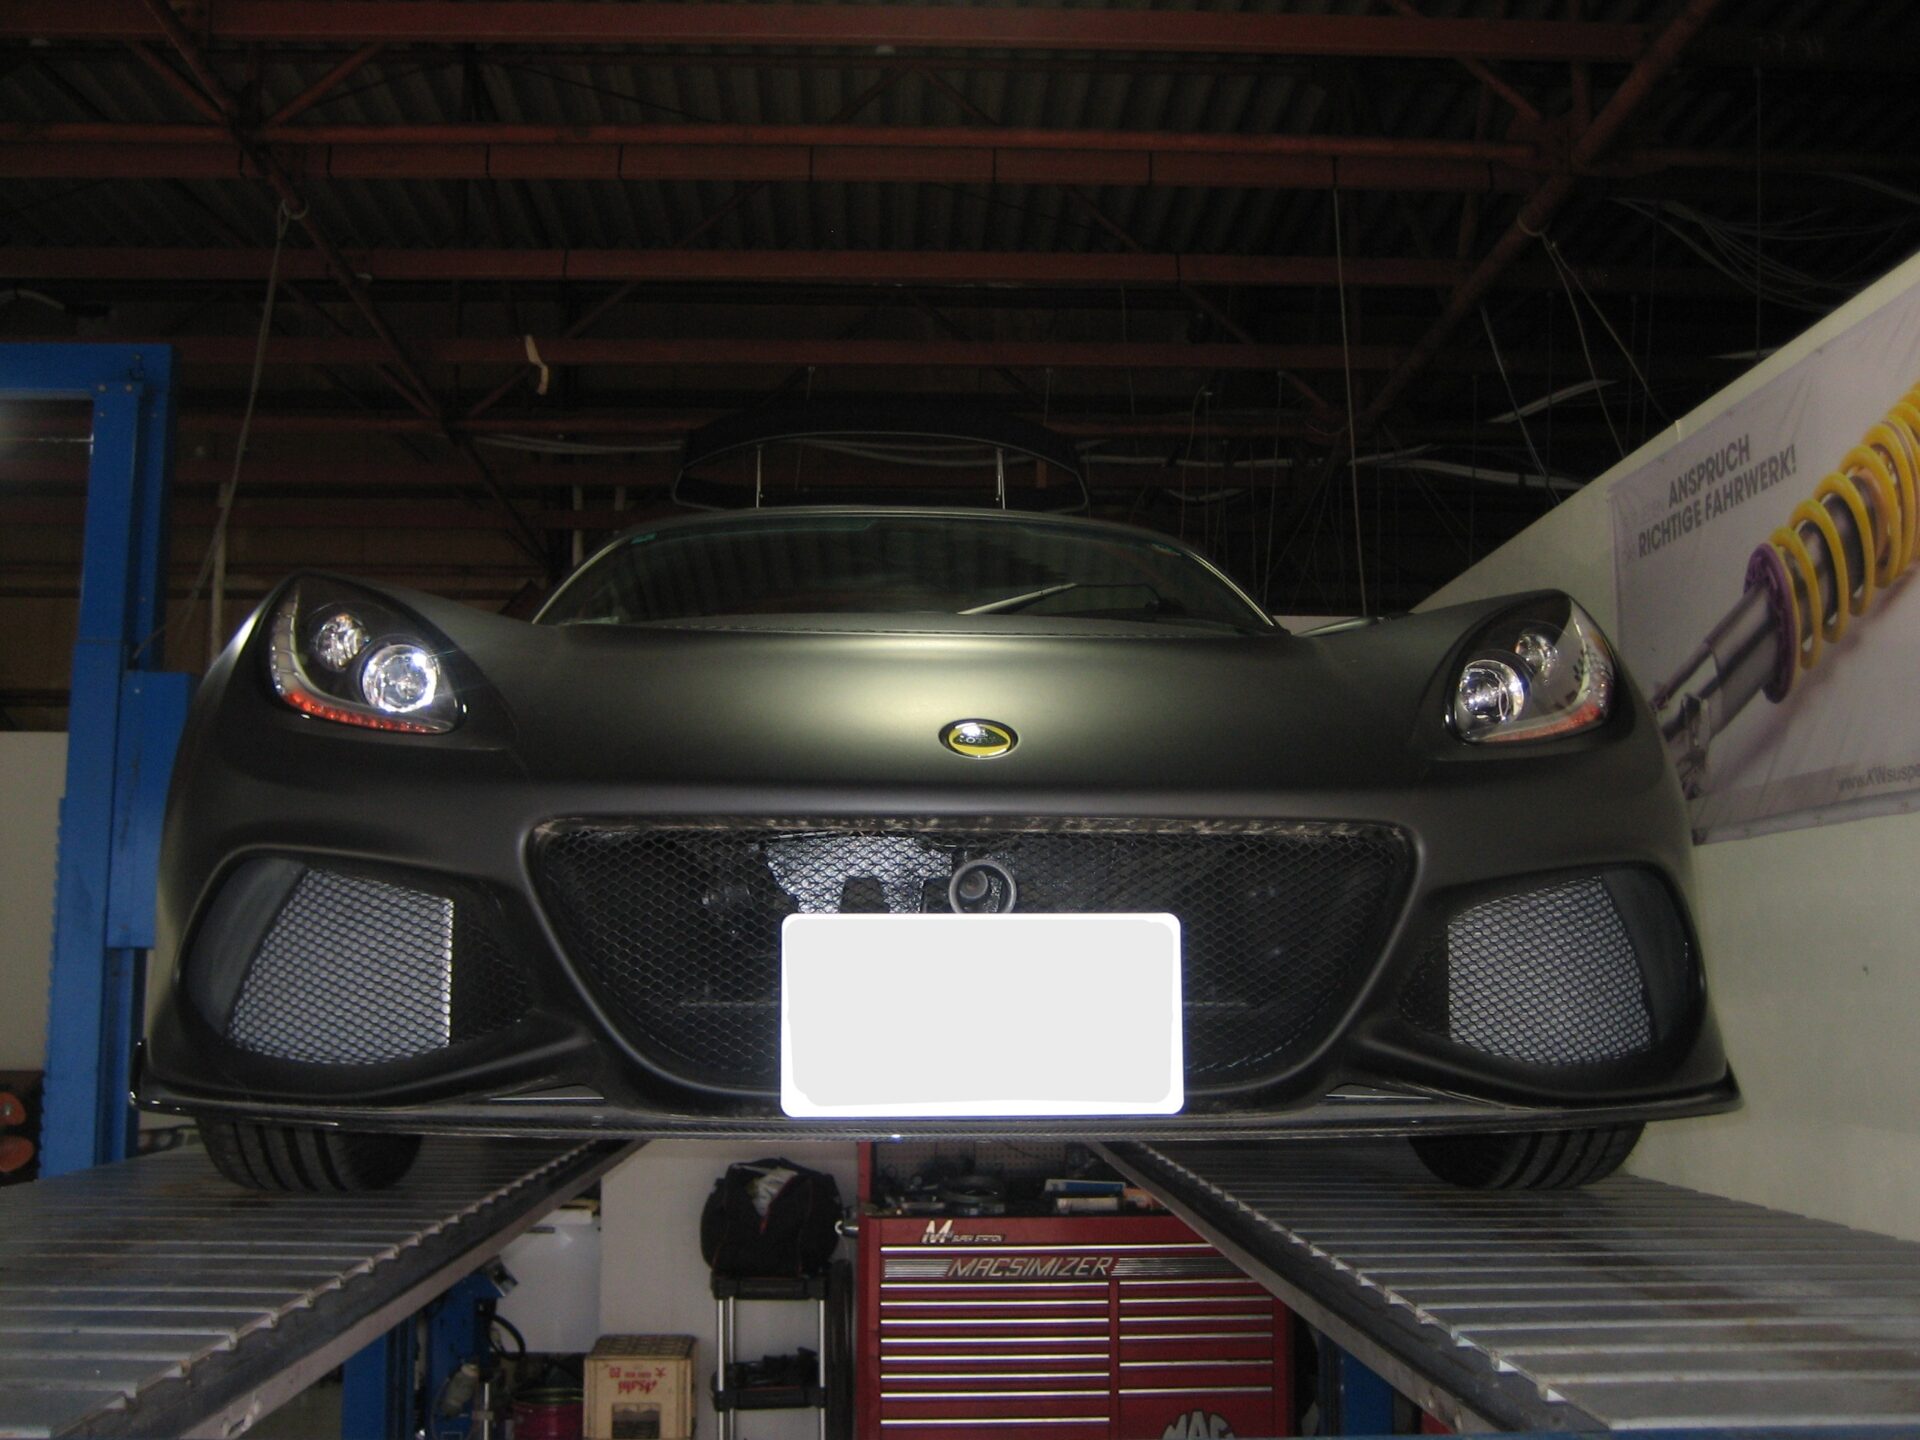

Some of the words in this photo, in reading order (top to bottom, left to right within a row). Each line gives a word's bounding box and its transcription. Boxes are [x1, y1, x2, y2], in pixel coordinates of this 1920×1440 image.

[1637, 502, 1702, 558] RICHTIGE
[1704, 444, 1797, 521] FAHRWERK!
[1668, 434, 1750, 508] ANSPRUCH
[948, 1256, 1113, 1277] MACSIMIZER
